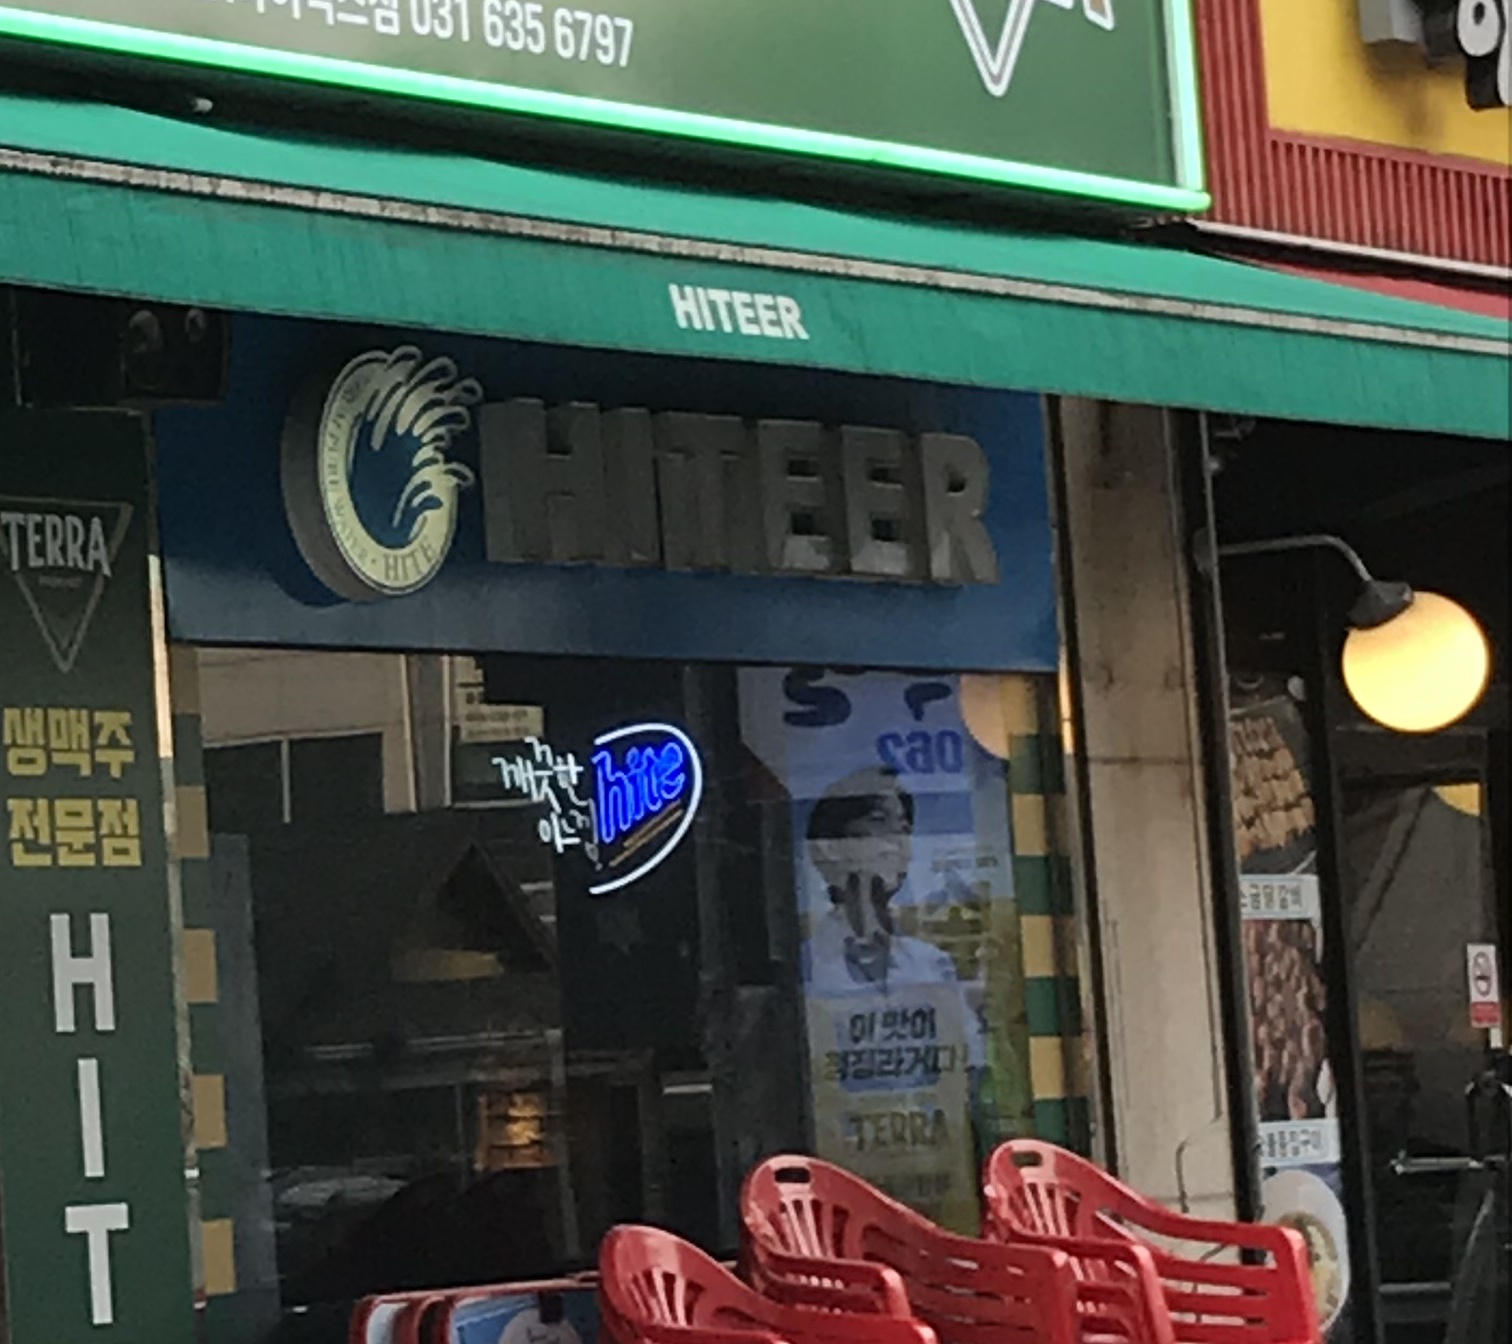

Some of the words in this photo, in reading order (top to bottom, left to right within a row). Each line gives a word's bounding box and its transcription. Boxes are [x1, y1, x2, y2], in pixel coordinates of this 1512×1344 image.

[482, 1, 546, 56] 635
[553, 8, 634, 67] 6797
[668, 283, 810, 341] HITEER
[480, 396, 1000, 585] HITEER
[0, 511, 113, 577] TERRA
[3, 707, 135, 779] 생맥주
[591, 742, 687, 843] hite
[7, 797, 142, 868] 전문점
